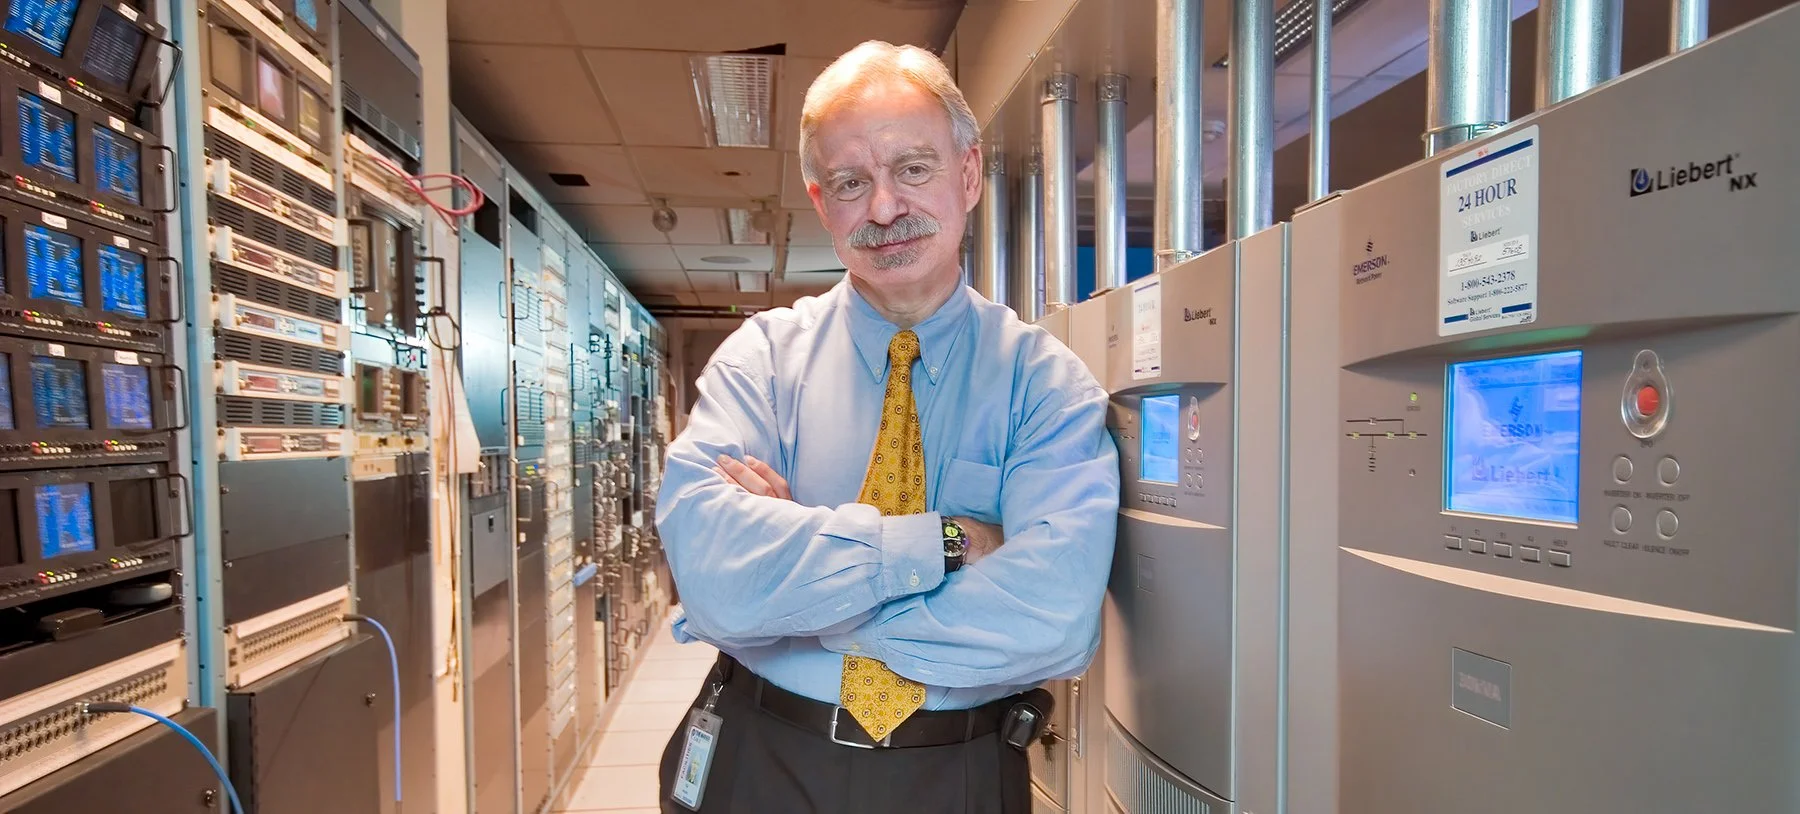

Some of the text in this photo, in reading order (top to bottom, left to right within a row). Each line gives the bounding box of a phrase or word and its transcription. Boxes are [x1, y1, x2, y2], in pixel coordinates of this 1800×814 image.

[1446, 154, 1532, 196] FACTORY DIRECT
[1656, 154, 1733, 190] Liebert
[1729, 172, 1757, 191] NX
[1458, 178, 1517, 213] 24 HOUR
[1462, 204, 1511, 227] SERVICES
[1479, 227, 1501, 240] Liebert
[1353, 254, 1387, 276] EMERSON
[1461, 270, 1516, 291] 1-800-543-2378
[1468, 293, 1487, 303] Support
